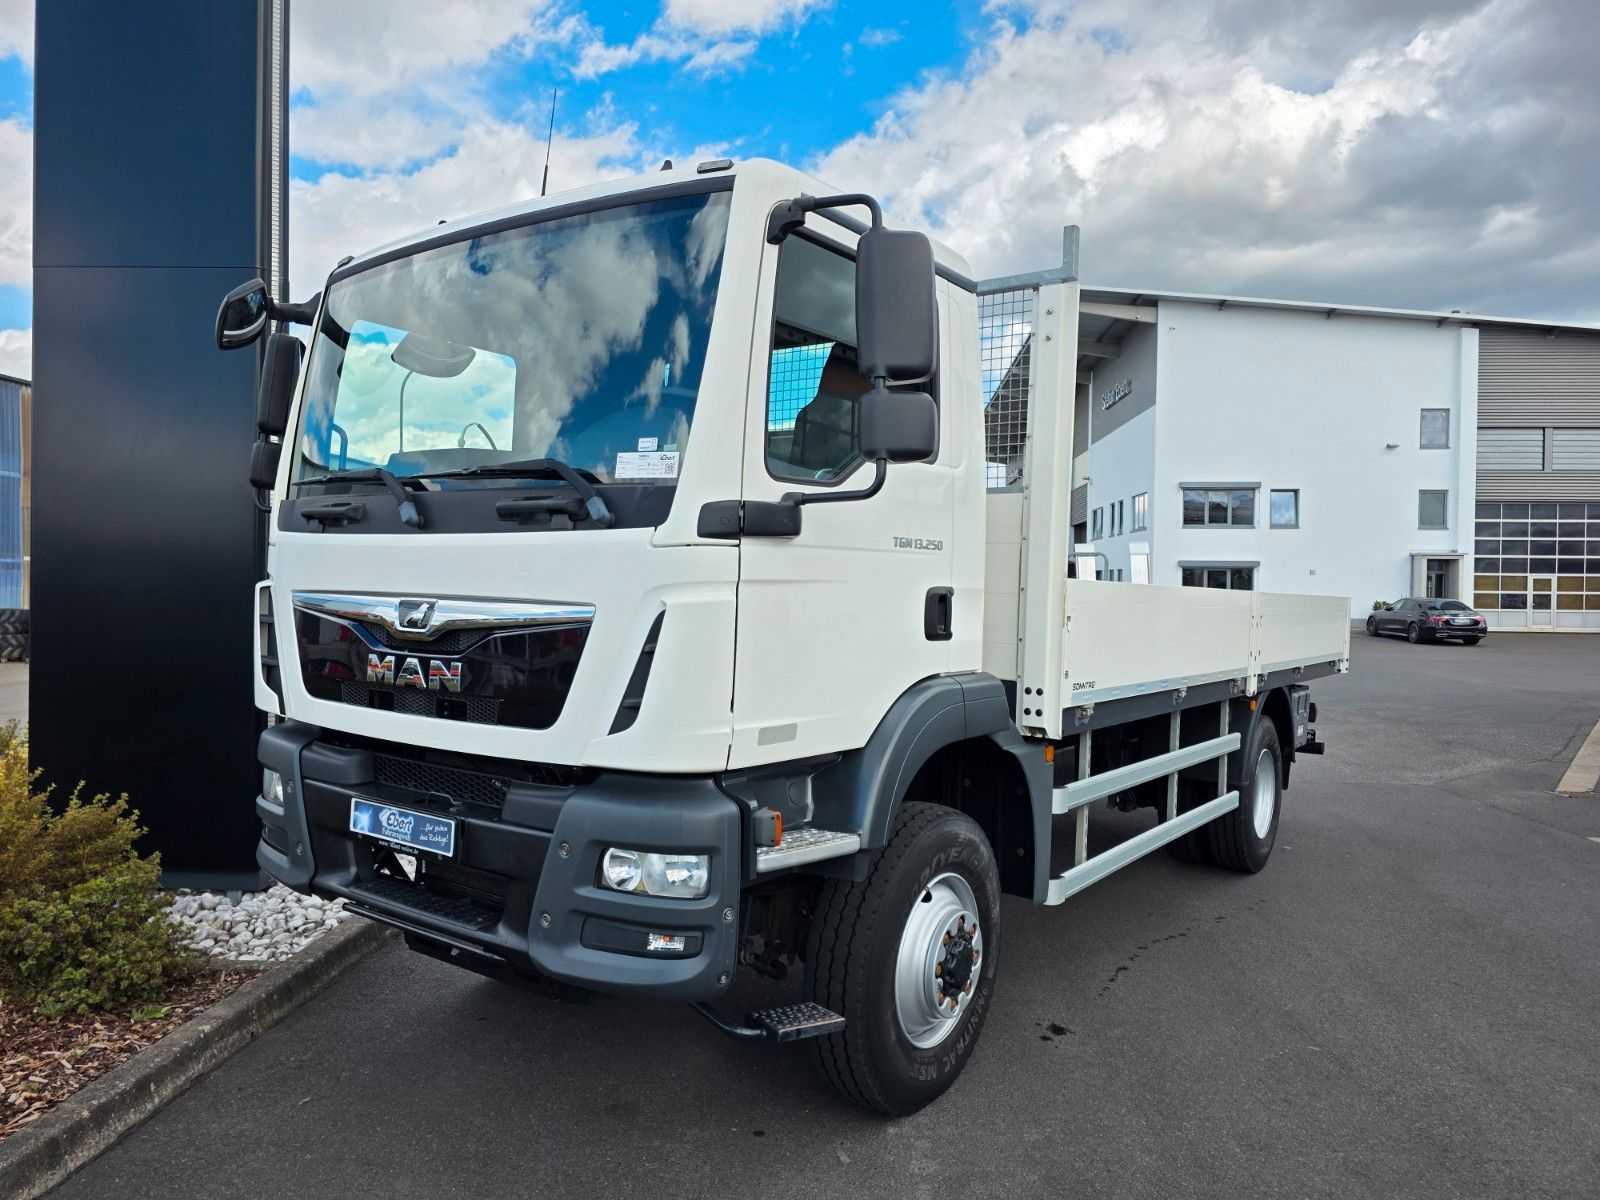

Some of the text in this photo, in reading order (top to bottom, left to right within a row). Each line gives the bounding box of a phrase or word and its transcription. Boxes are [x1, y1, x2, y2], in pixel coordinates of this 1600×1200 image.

[893, 536, 944, 551] TGM 13.250
[367, 653, 463, 693] MAN
[386, 811, 413, 831] Ebert
